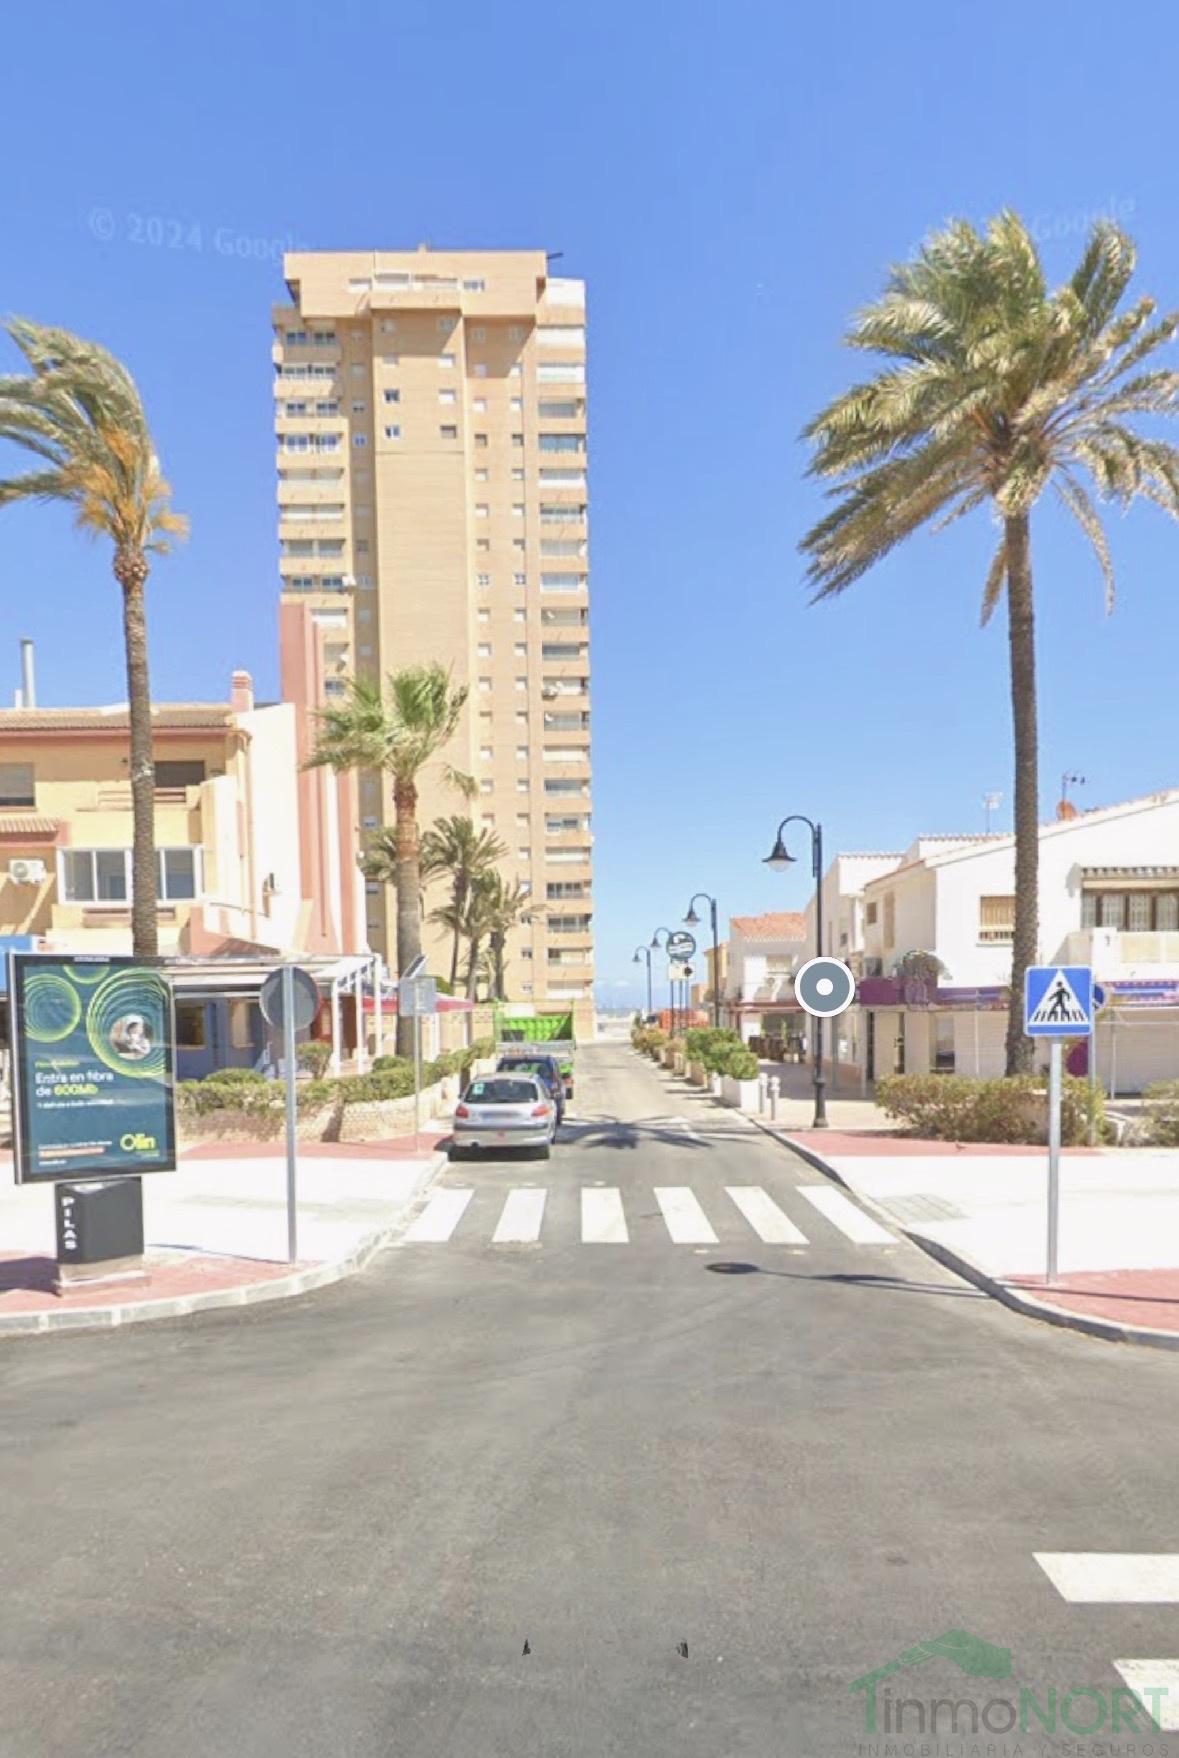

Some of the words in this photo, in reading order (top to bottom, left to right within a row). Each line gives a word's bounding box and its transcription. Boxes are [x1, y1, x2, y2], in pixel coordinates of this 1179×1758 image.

[69, 1072, 85, 1083] en
[86, 1070, 114, 1083] fibra
[36, 1087, 51, 1098] de
[62, 1196, 77, 1250] PILAS
